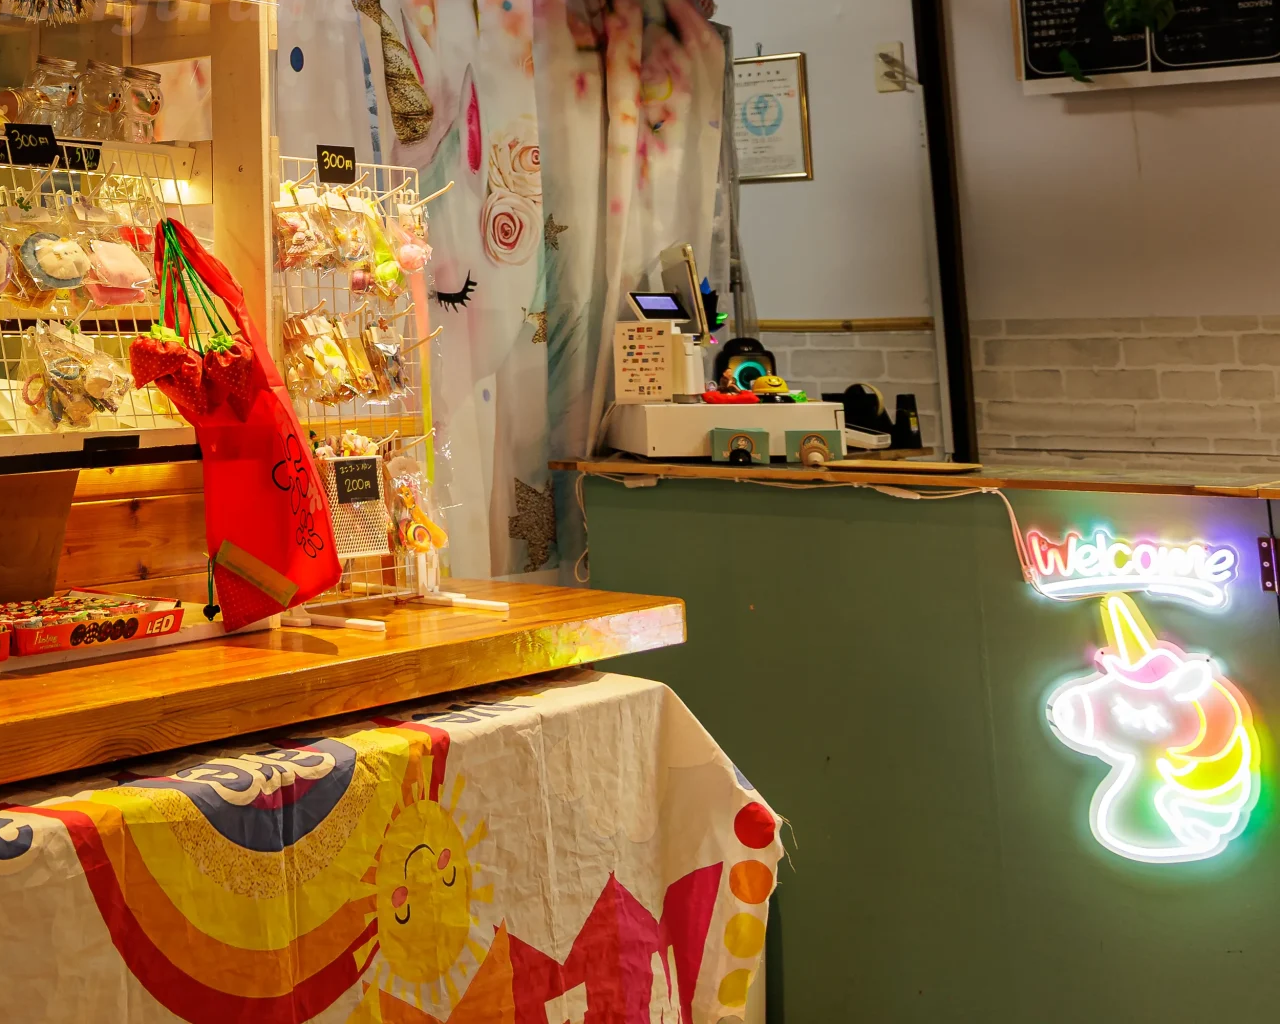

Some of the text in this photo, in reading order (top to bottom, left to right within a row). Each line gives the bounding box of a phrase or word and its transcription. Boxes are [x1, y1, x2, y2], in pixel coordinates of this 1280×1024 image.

[321, 151, 353, 171] 300円
[1031, 533, 1236, 583] Welcome
[145, 614, 175, 635] LED
